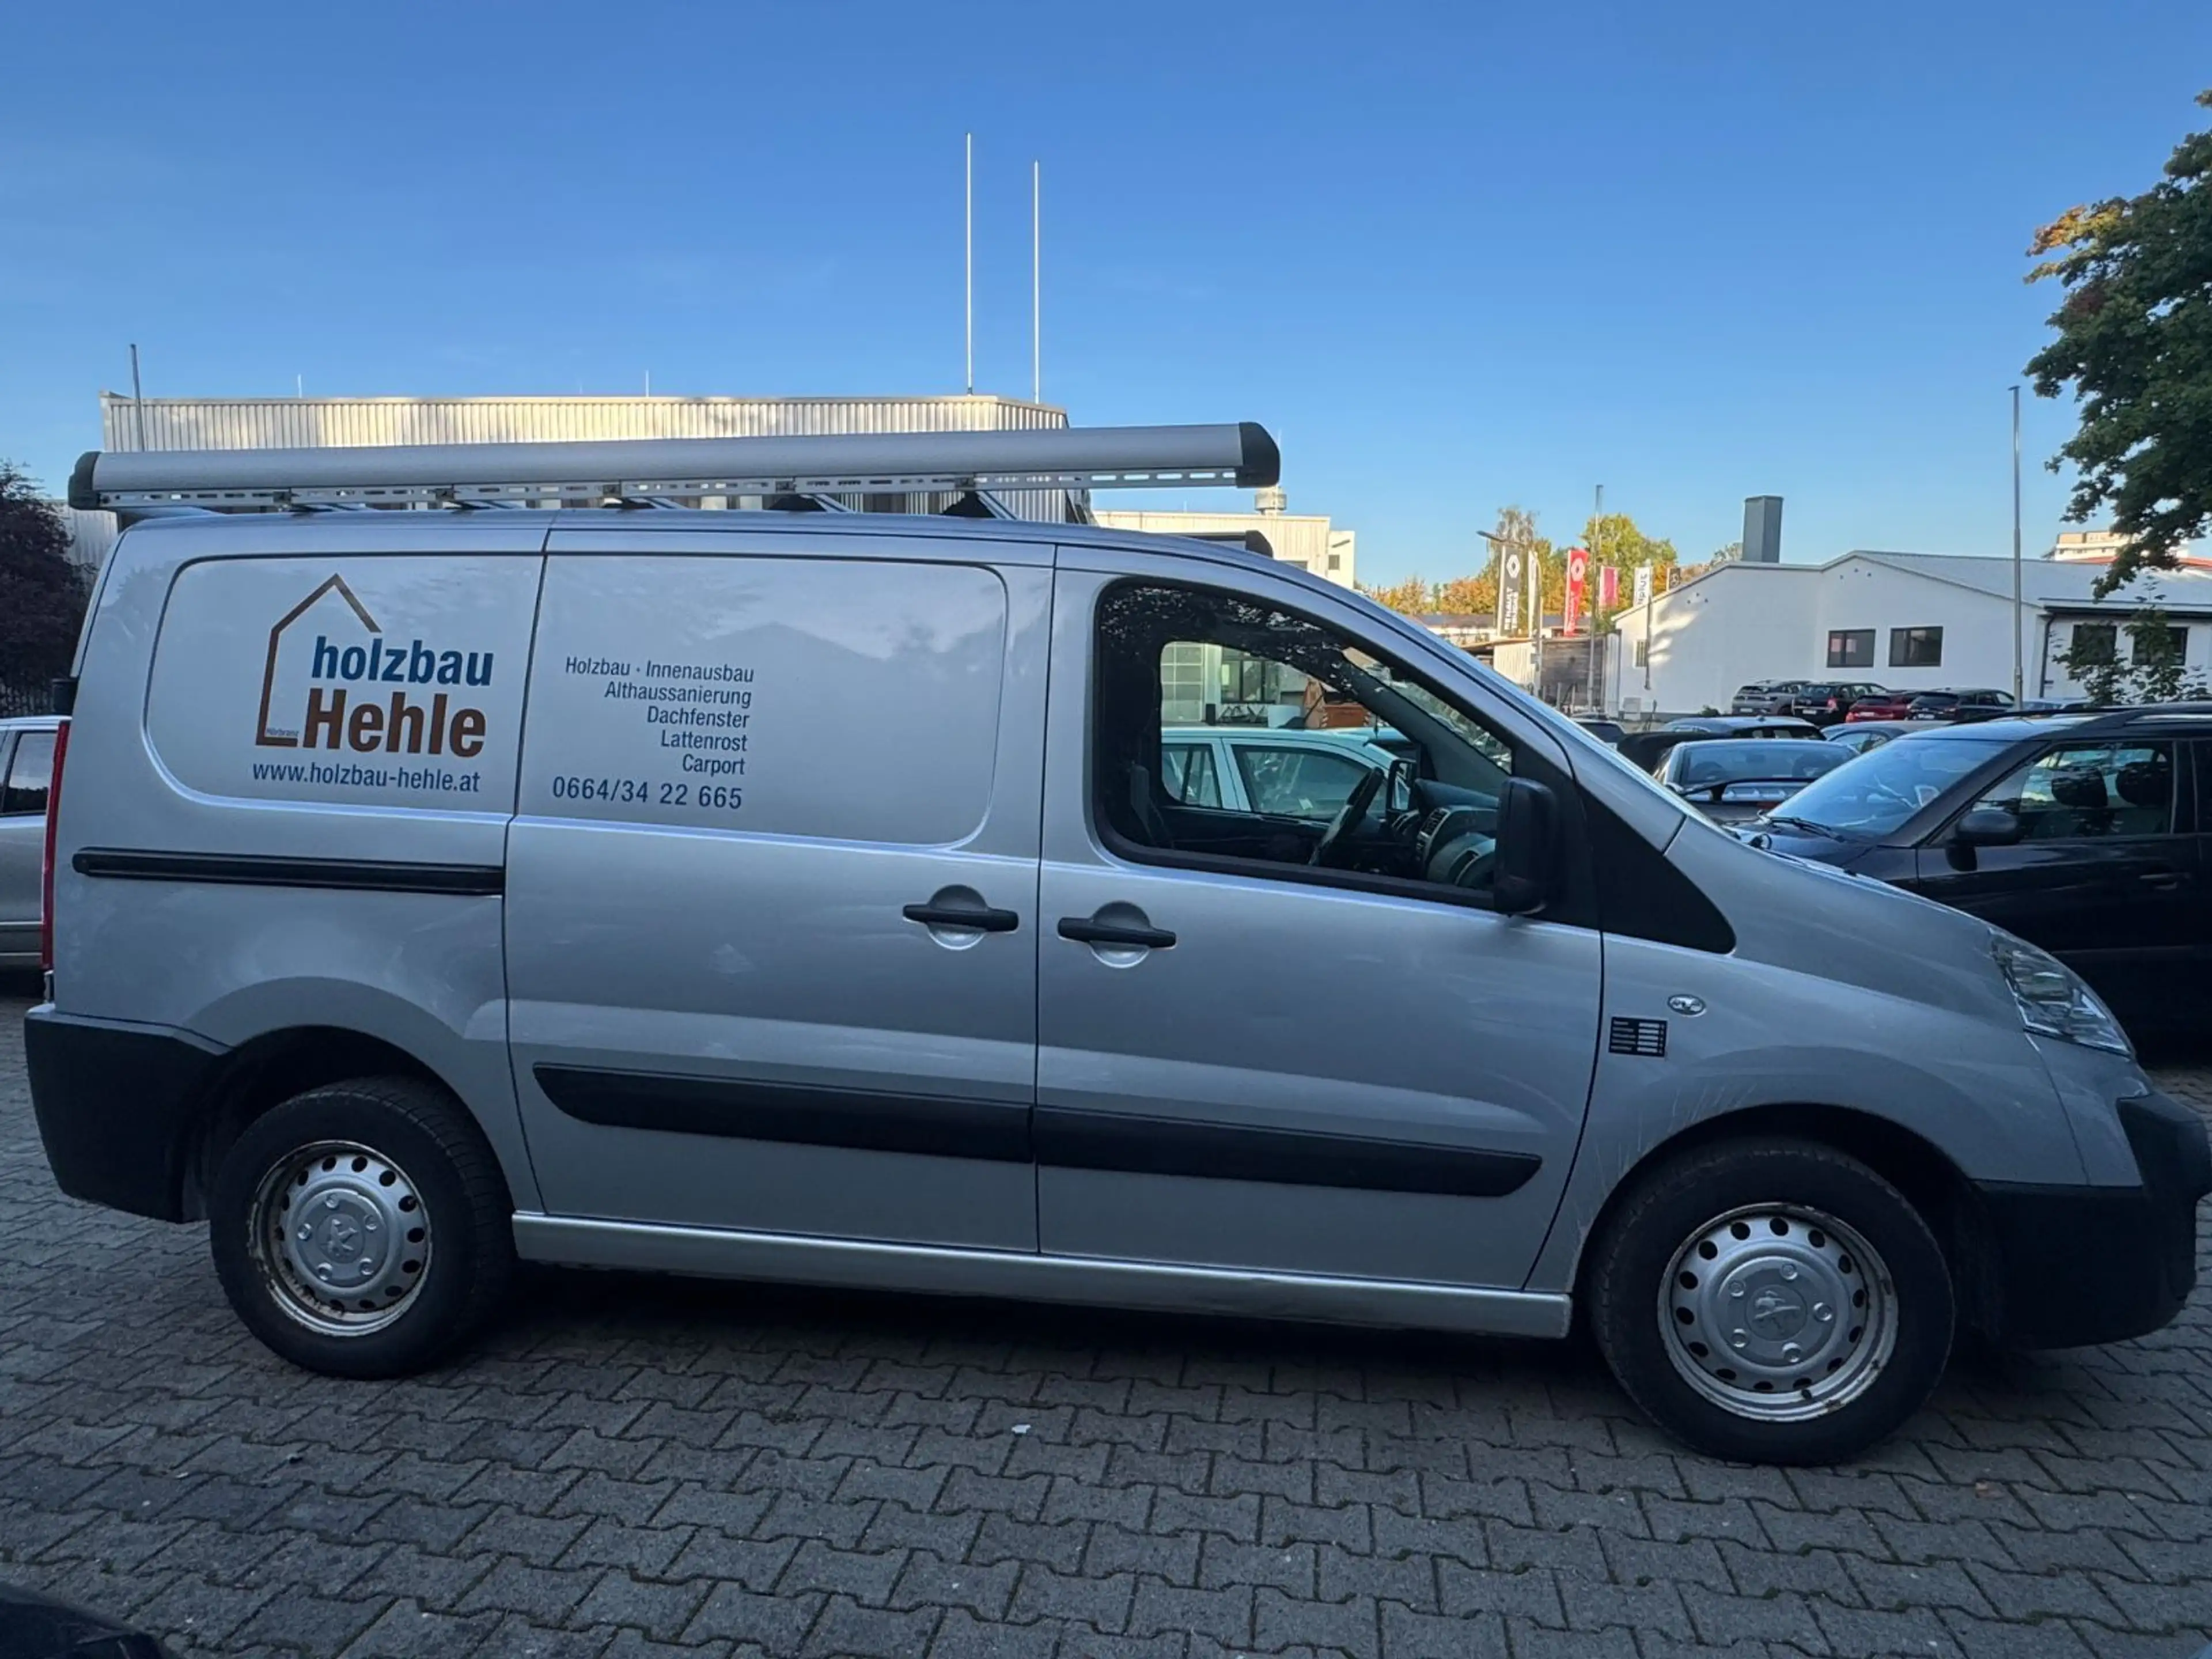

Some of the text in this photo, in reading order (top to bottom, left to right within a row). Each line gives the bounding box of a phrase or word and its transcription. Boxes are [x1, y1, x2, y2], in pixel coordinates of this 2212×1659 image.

[312, 635, 494, 686] holzbau
[565, 657, 754, 683] Holzbau Innenausbau
[604, 681, 752, 709] Althaussanierung
[302, 688, 486, 757] Hehle
[647, 706, 750, 729] Dachfenster
[661, 730, 748, 752] Lattenrost
[253, 762, 480, 792] www.holzbau-hehle.at
[682, 753, 745, 777] Carport
[552, 776, 743, 809] 0664/34 22 665
